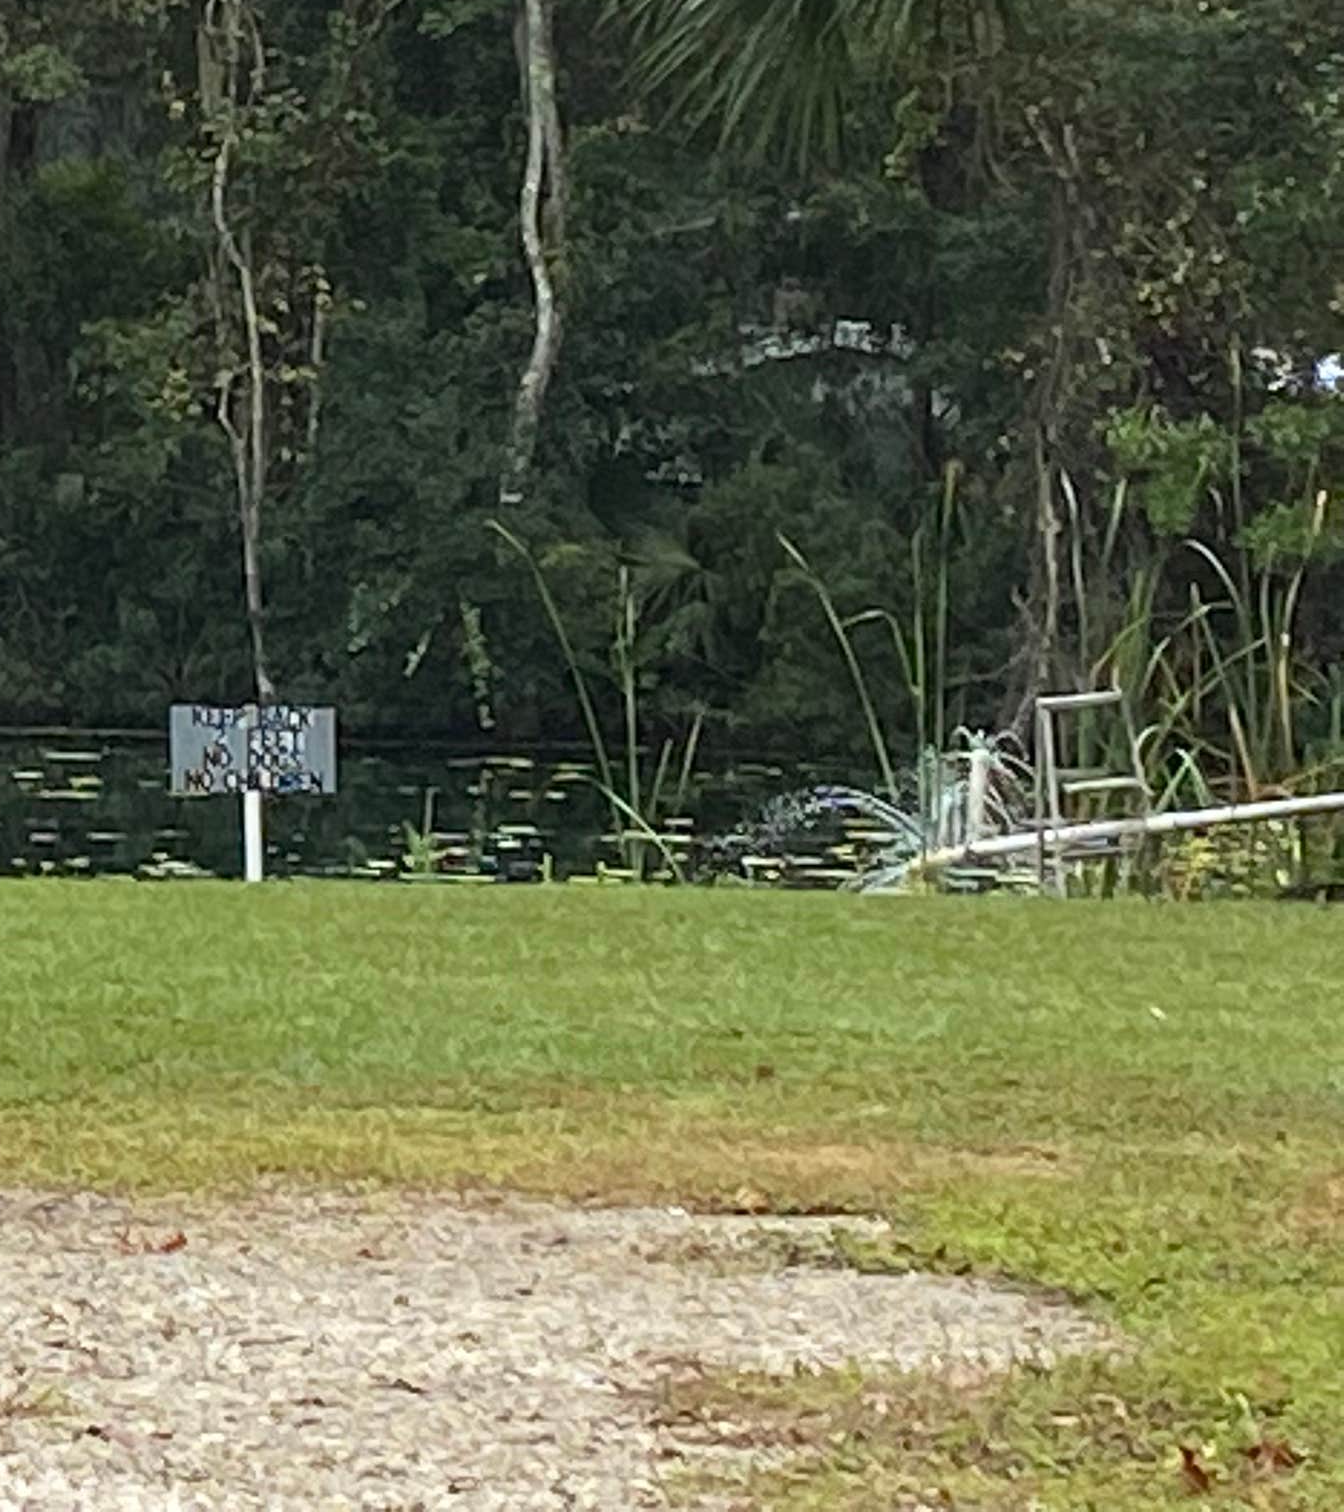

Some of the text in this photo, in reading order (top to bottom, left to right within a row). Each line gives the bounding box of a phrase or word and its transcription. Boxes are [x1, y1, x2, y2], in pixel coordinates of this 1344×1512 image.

[202, 745, 233, 768] NO
[184, 769, 323, 792] NO CHILDREN
